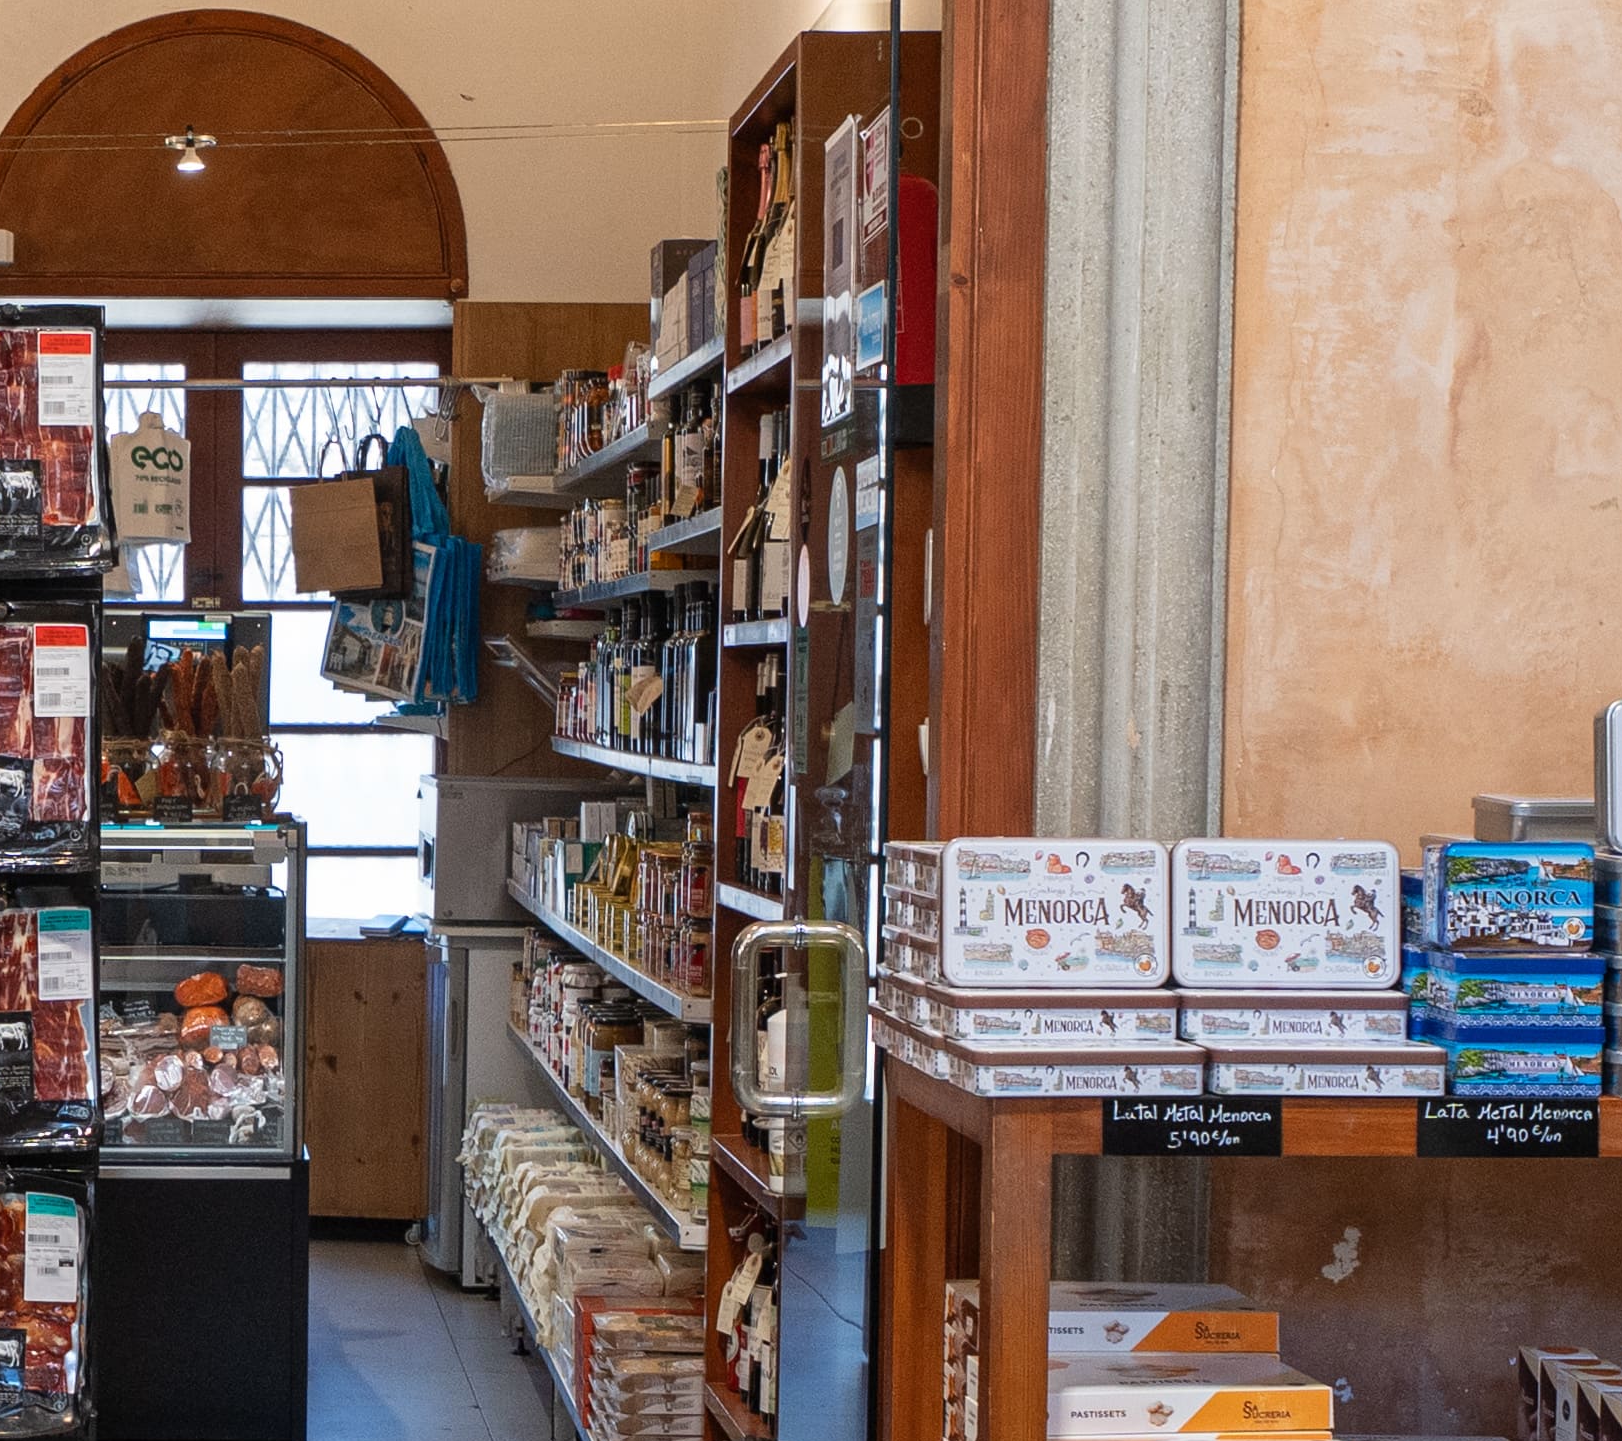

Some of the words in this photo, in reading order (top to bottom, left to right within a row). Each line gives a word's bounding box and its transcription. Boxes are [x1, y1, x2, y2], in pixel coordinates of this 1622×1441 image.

[131, 446, 183, 472] eco
[1459, 890, 1582, 906] MENORCA
[1005, 897, 1110, 926] MENORCA
[1234, 898, 1340, 926] MENORCA
[1044, 1019, 1094, 1034] MENORCA
[1273, 1020, 1323, 1034] MENORCA
[1066, 1075, 1117, 1090] MENORCA
[1308, 1075, 1359, 1089] MENORCA
[1195, 1329, 1241, 1340] SUCRERIA
[1071, 1410, 1127, 1419] PASTISSETS
[1243, 1408, 1291, 1419] SUCRERIA
